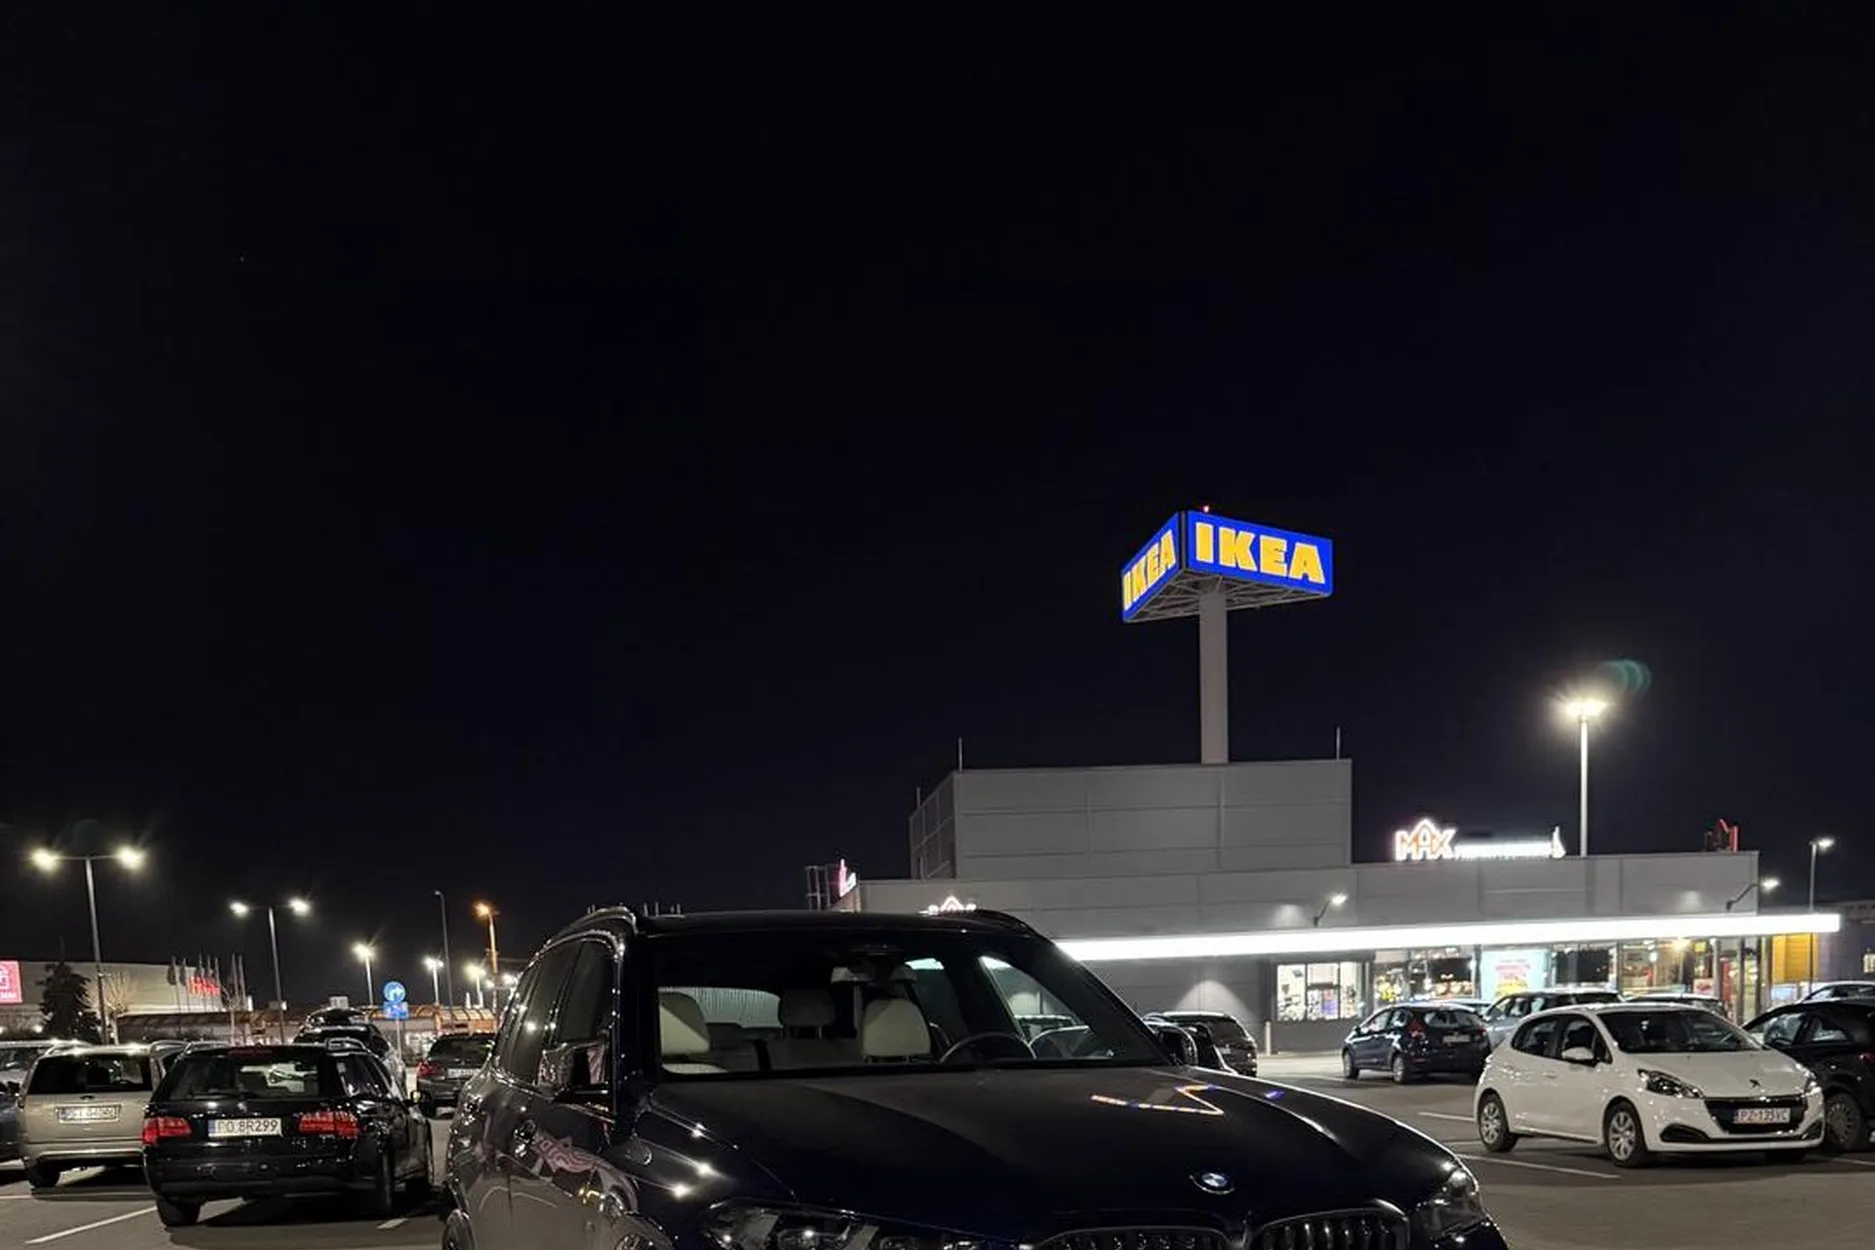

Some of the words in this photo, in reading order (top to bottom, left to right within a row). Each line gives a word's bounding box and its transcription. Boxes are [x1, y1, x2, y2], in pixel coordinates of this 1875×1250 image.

[1123, 529, 1177, 610] IKEA
[1195, 521, 1325, 584] IKEA
[1395, 818, 1456, 861] MAX
[238, 1120, 278, 1132] 8R299
